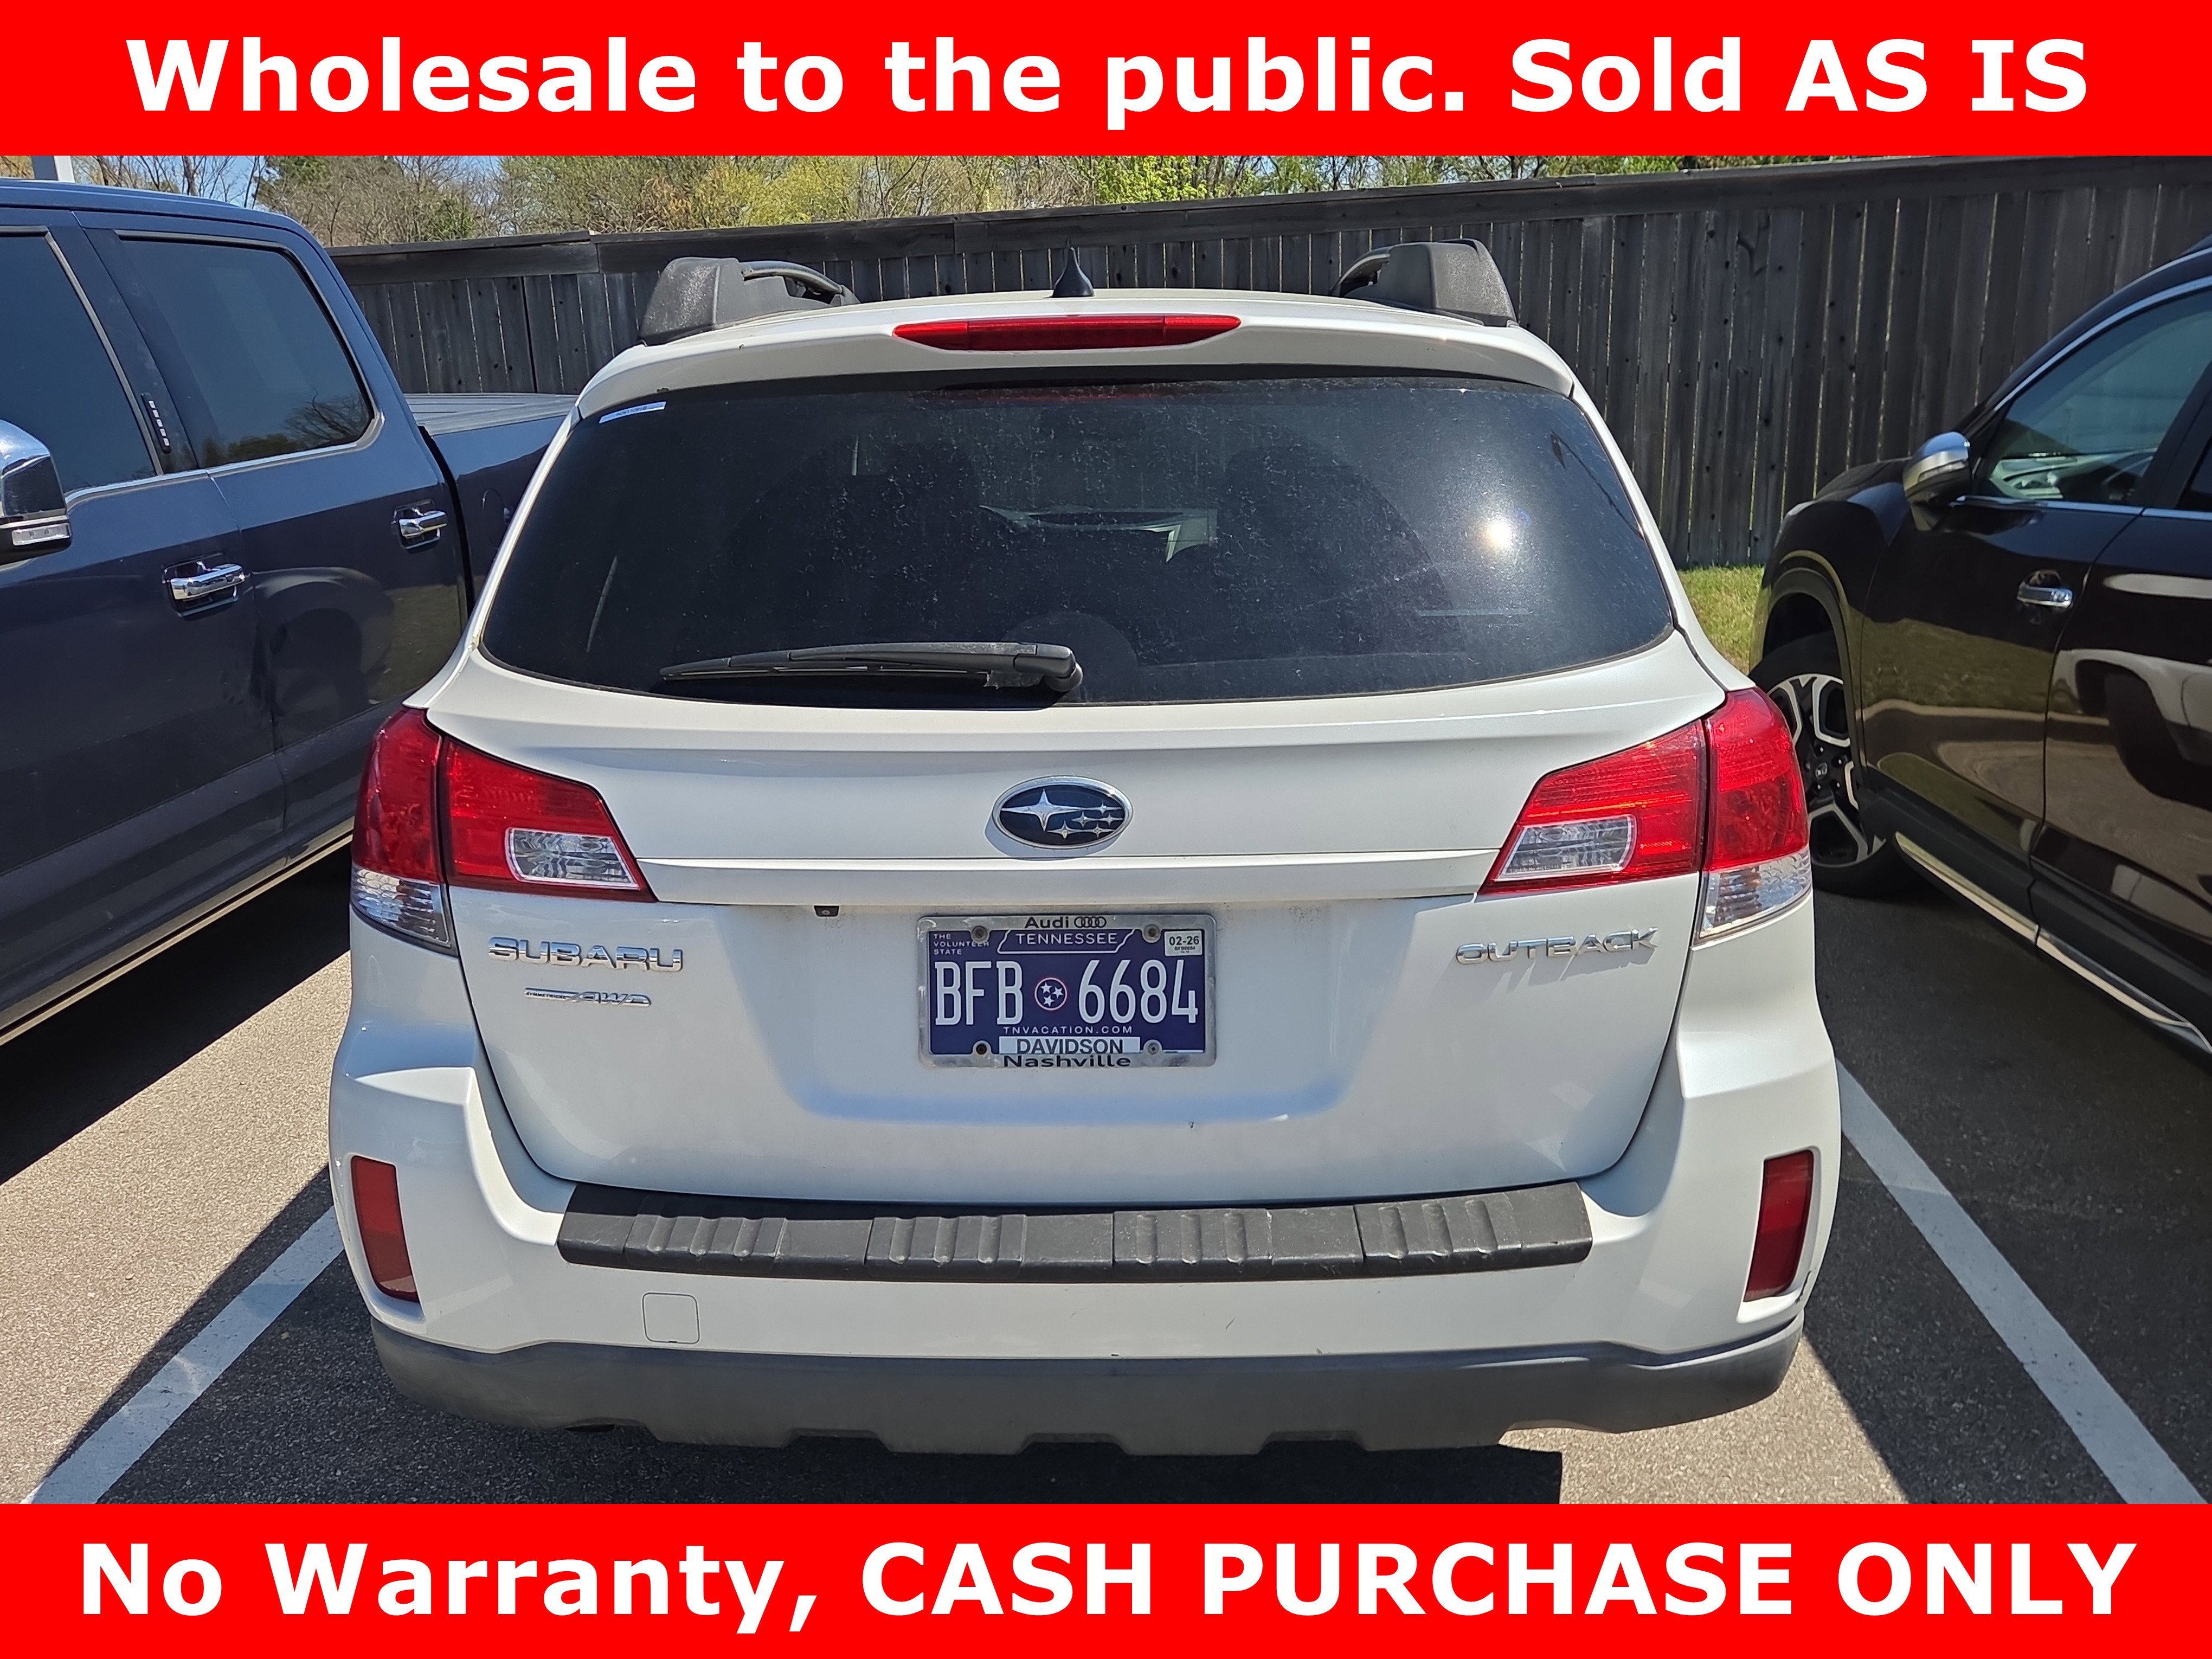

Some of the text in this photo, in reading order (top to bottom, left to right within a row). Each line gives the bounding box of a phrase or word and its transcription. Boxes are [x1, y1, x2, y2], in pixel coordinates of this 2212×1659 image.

[1024, 916, 1069, 929] Audi
[1015, 933, 1118, 945] TENNESSEE
[1169, 935, 1200, 946] 02-26
[1455, 927, 1659, 964] OUTBACK
[488, 936, 684, 973] SUBARU
[934, 959, 1198, 1025] BFB 6684
[567, 992, 652, 1007] AWD
[1003, 1026, 1133, 1034] TNVACATION.COM
[1017, 1038, 1123, 1054] DAVIDSON
[1004, 1055, 1131, 1068] Nashville
